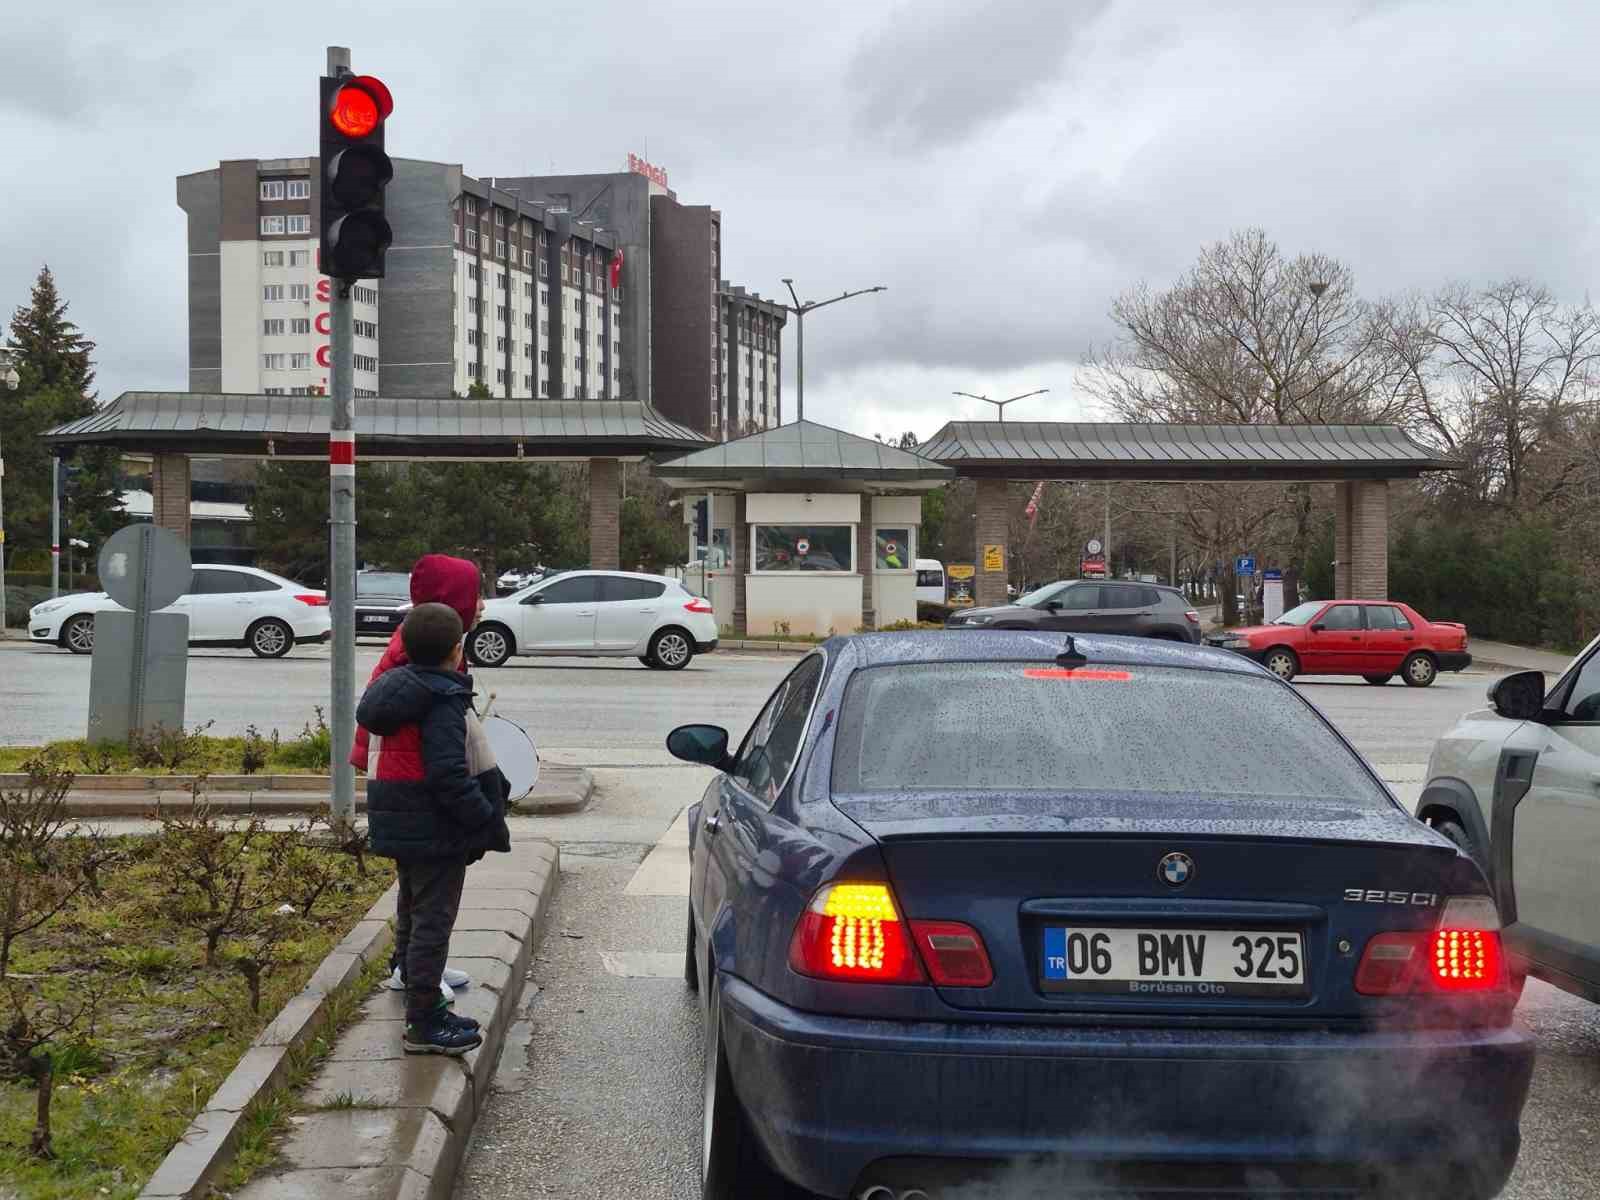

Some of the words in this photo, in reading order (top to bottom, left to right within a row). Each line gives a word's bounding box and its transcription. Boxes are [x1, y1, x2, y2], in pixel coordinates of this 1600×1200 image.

[1240, 559, 1249, 568] P
[1067, 932, 1112, 975] 06
[1137, 933, 1206, 977] BMV
[1231, 935, 1300, 979] 325
[1048, 957, 1065, 969] TR
[1129, 981, 1193, 993] Borusan
[1199, 982, 1226, 994] Oto
